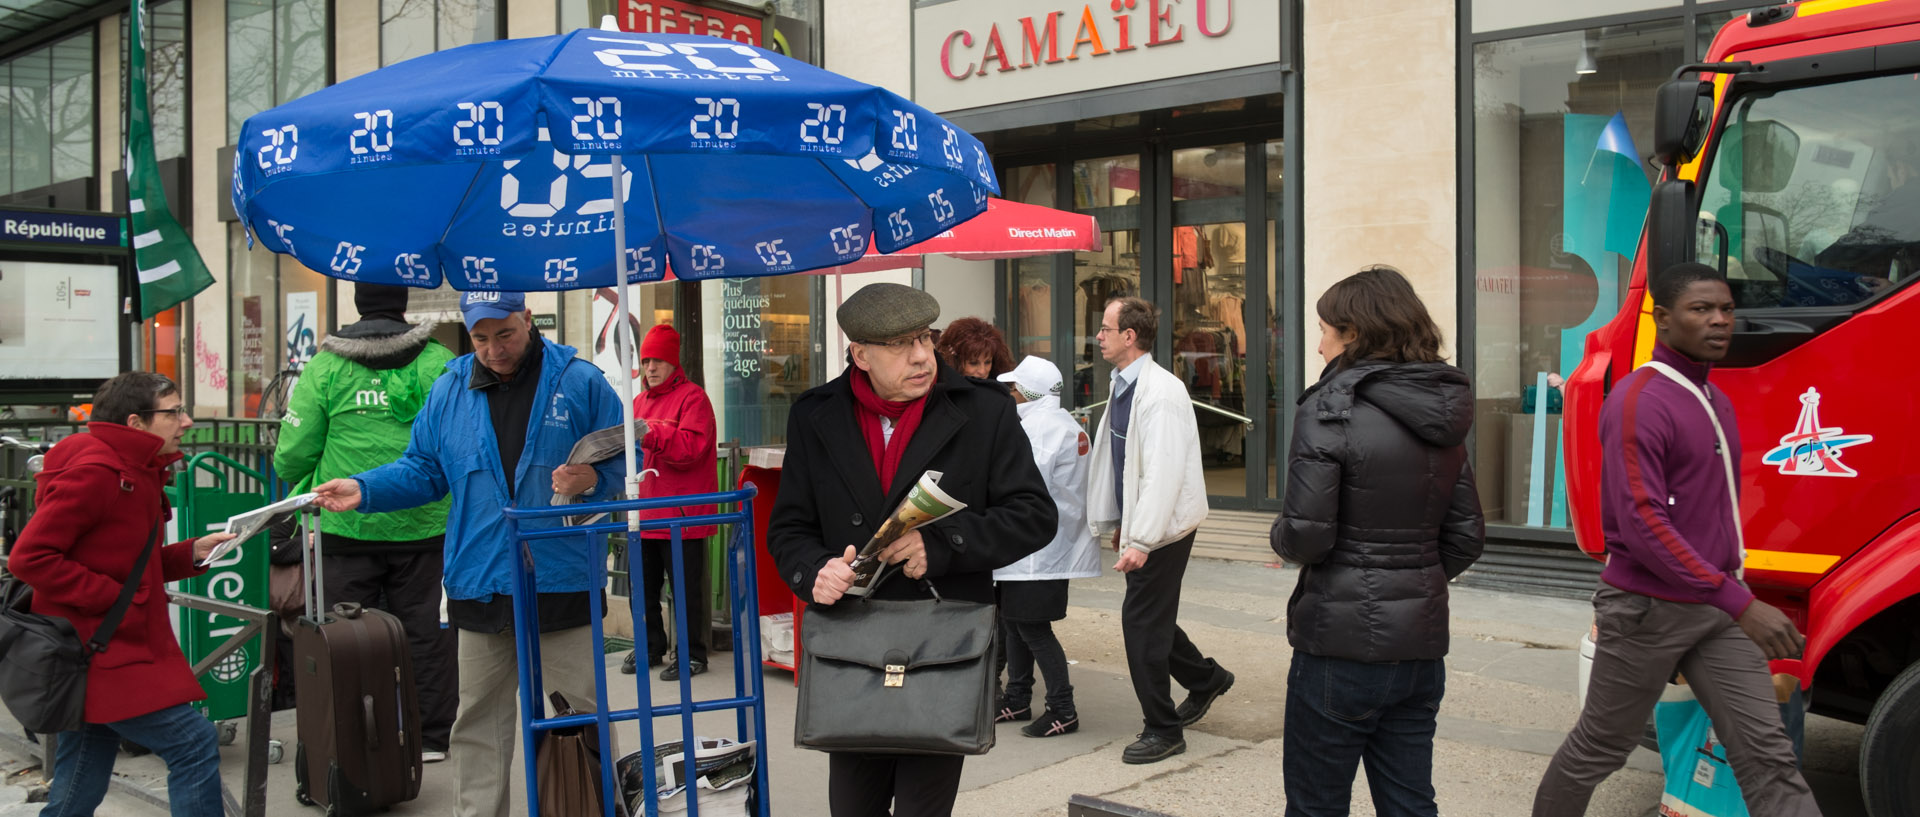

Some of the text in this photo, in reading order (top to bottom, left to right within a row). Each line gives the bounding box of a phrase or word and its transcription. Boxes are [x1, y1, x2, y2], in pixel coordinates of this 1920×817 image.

[587, 36, 781, 74] 20
[611, 69, 790, 82] minutes
[453, 101, 503, 146] 20
[571, 97, 622, 140] 20
[690, 97, 740, 139] 20
[800, 102, 846, 144] 20
[350, 109, 394, 155] 20
[892, 110, 918, 151] 20
[258, 124, 298, 169] 20
[455, 146, 501, 156] minutes
[573, 141, 622, 150] minutes
[691, 140, 737, 149] minutes
[800, 144, 842, 154] minutes
[888, 150, 919, 160] minutes
[942, 124, 963, 164] 20
[350, 152, 393, 165] minutes
[266, 165, 292, 178] inutes
[5, 219, 106, 242] République
[1008, 227, 1076, 238] Direct Matin
[720, 282, 742, 297] Plus
[724, 294, 769, 314] quelques
[720, 313, 761, 335] jours
[718, 334, 767, 359] profiter
[725, 331, 740, 340] pour
[733, 353, 761, 378] âge.
